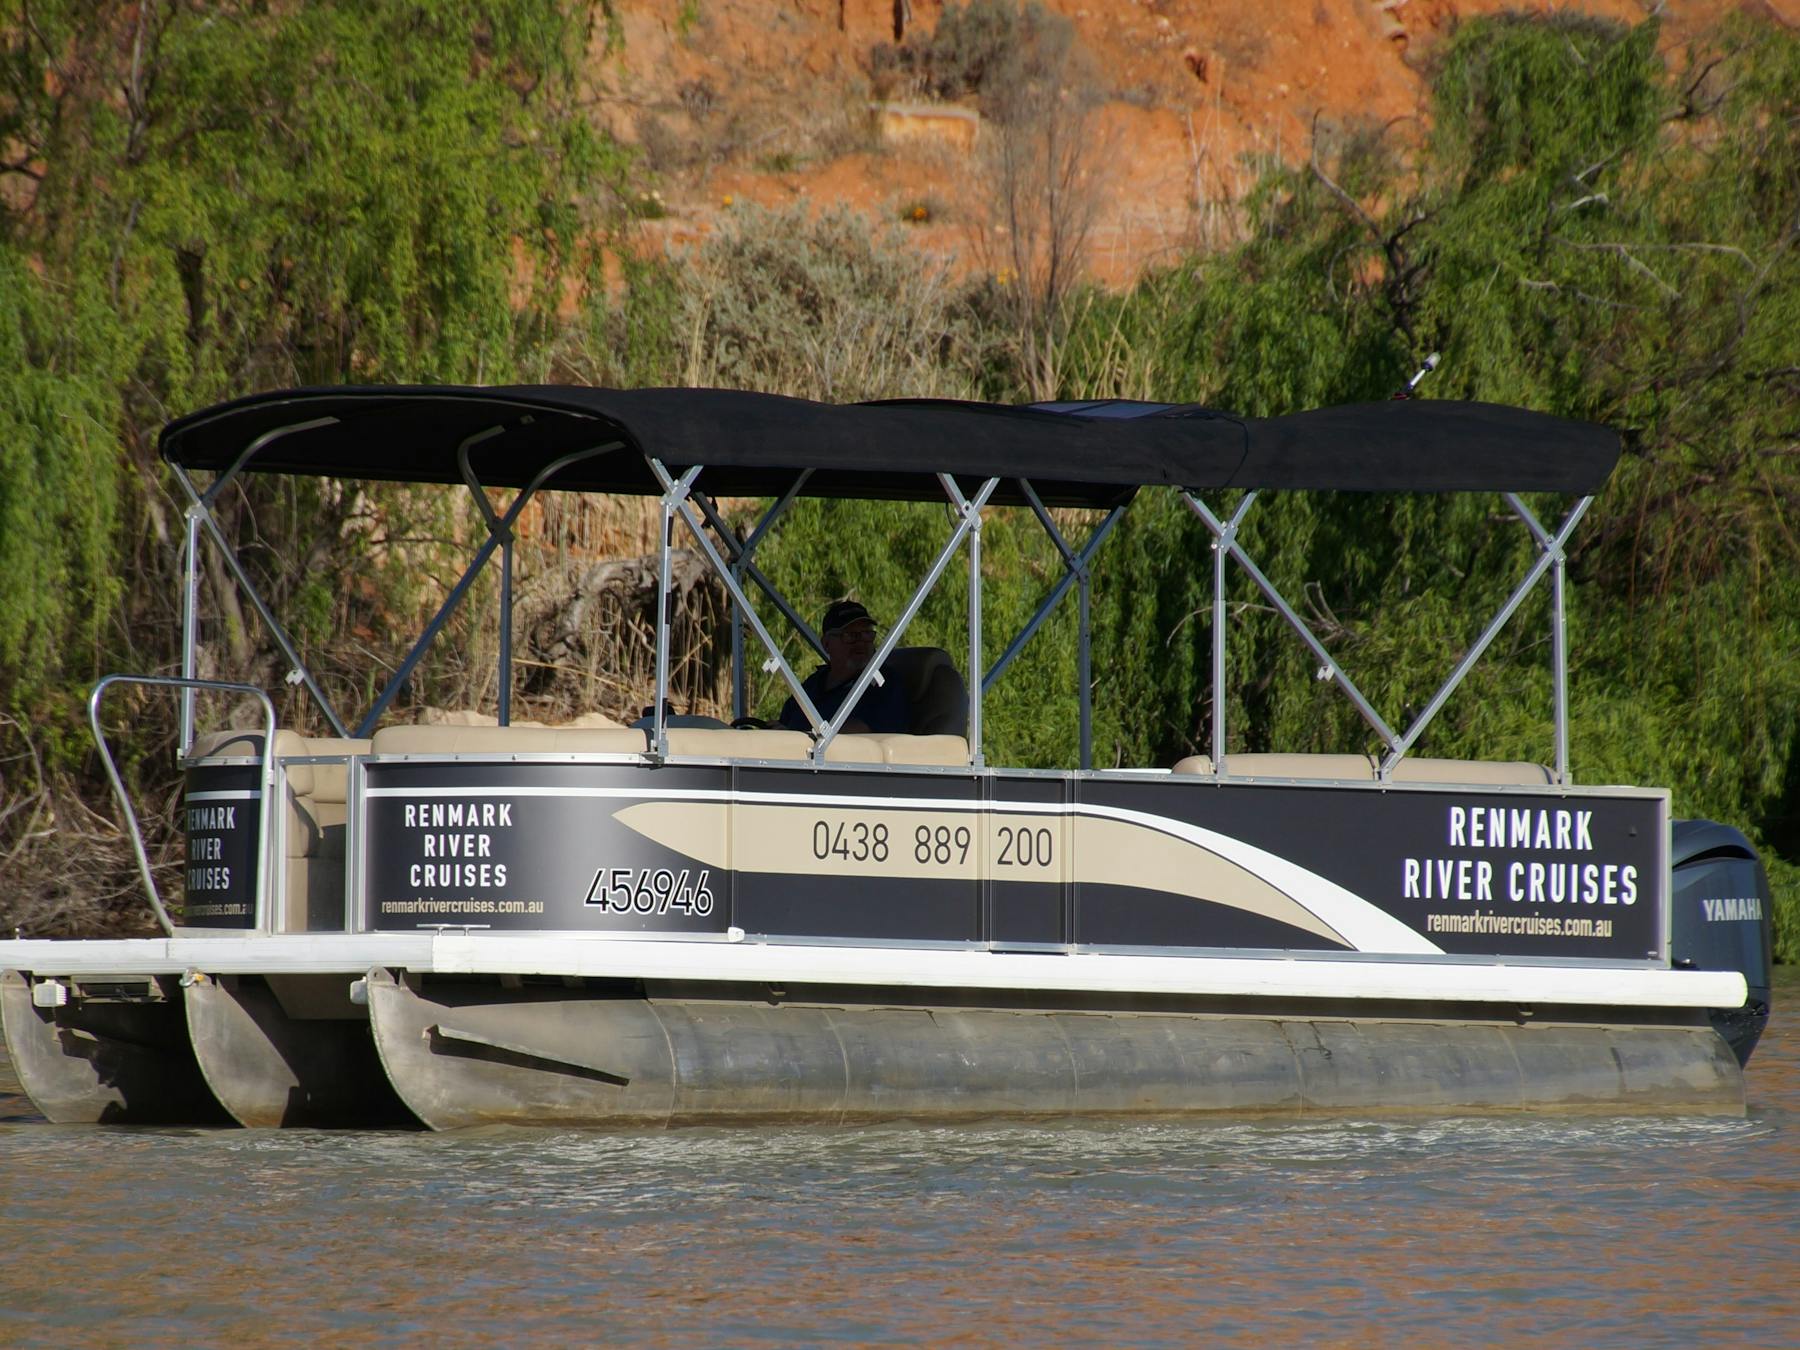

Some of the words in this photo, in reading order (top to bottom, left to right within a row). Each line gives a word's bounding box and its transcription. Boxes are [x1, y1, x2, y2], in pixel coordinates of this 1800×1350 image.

[405, 804, 513, 828] RENMARK
[1450, 806, 1594, 851] RENMARK
[191, 838, 222, 860] RIVER
[424, 834, 491, 857] RIVER
[813, 820, 890, 863] 0438
[914, 825, 972, 865] 889
[997, 826, 1053, 867] 200
[410, 864, 507, 888] CRUISES
[1404, 858, 1493, 901] RIVER
[1509, 862, 1638, 906] CRUISES
[584, 868, 714, 917] 456946
[382, 898, 544, 914] renmarkrivercruises.com.au
[1703, 898, 1763, 922] YAMAHA
[1427, 910, 1613, 938] renmarkrivercruises.com.au
